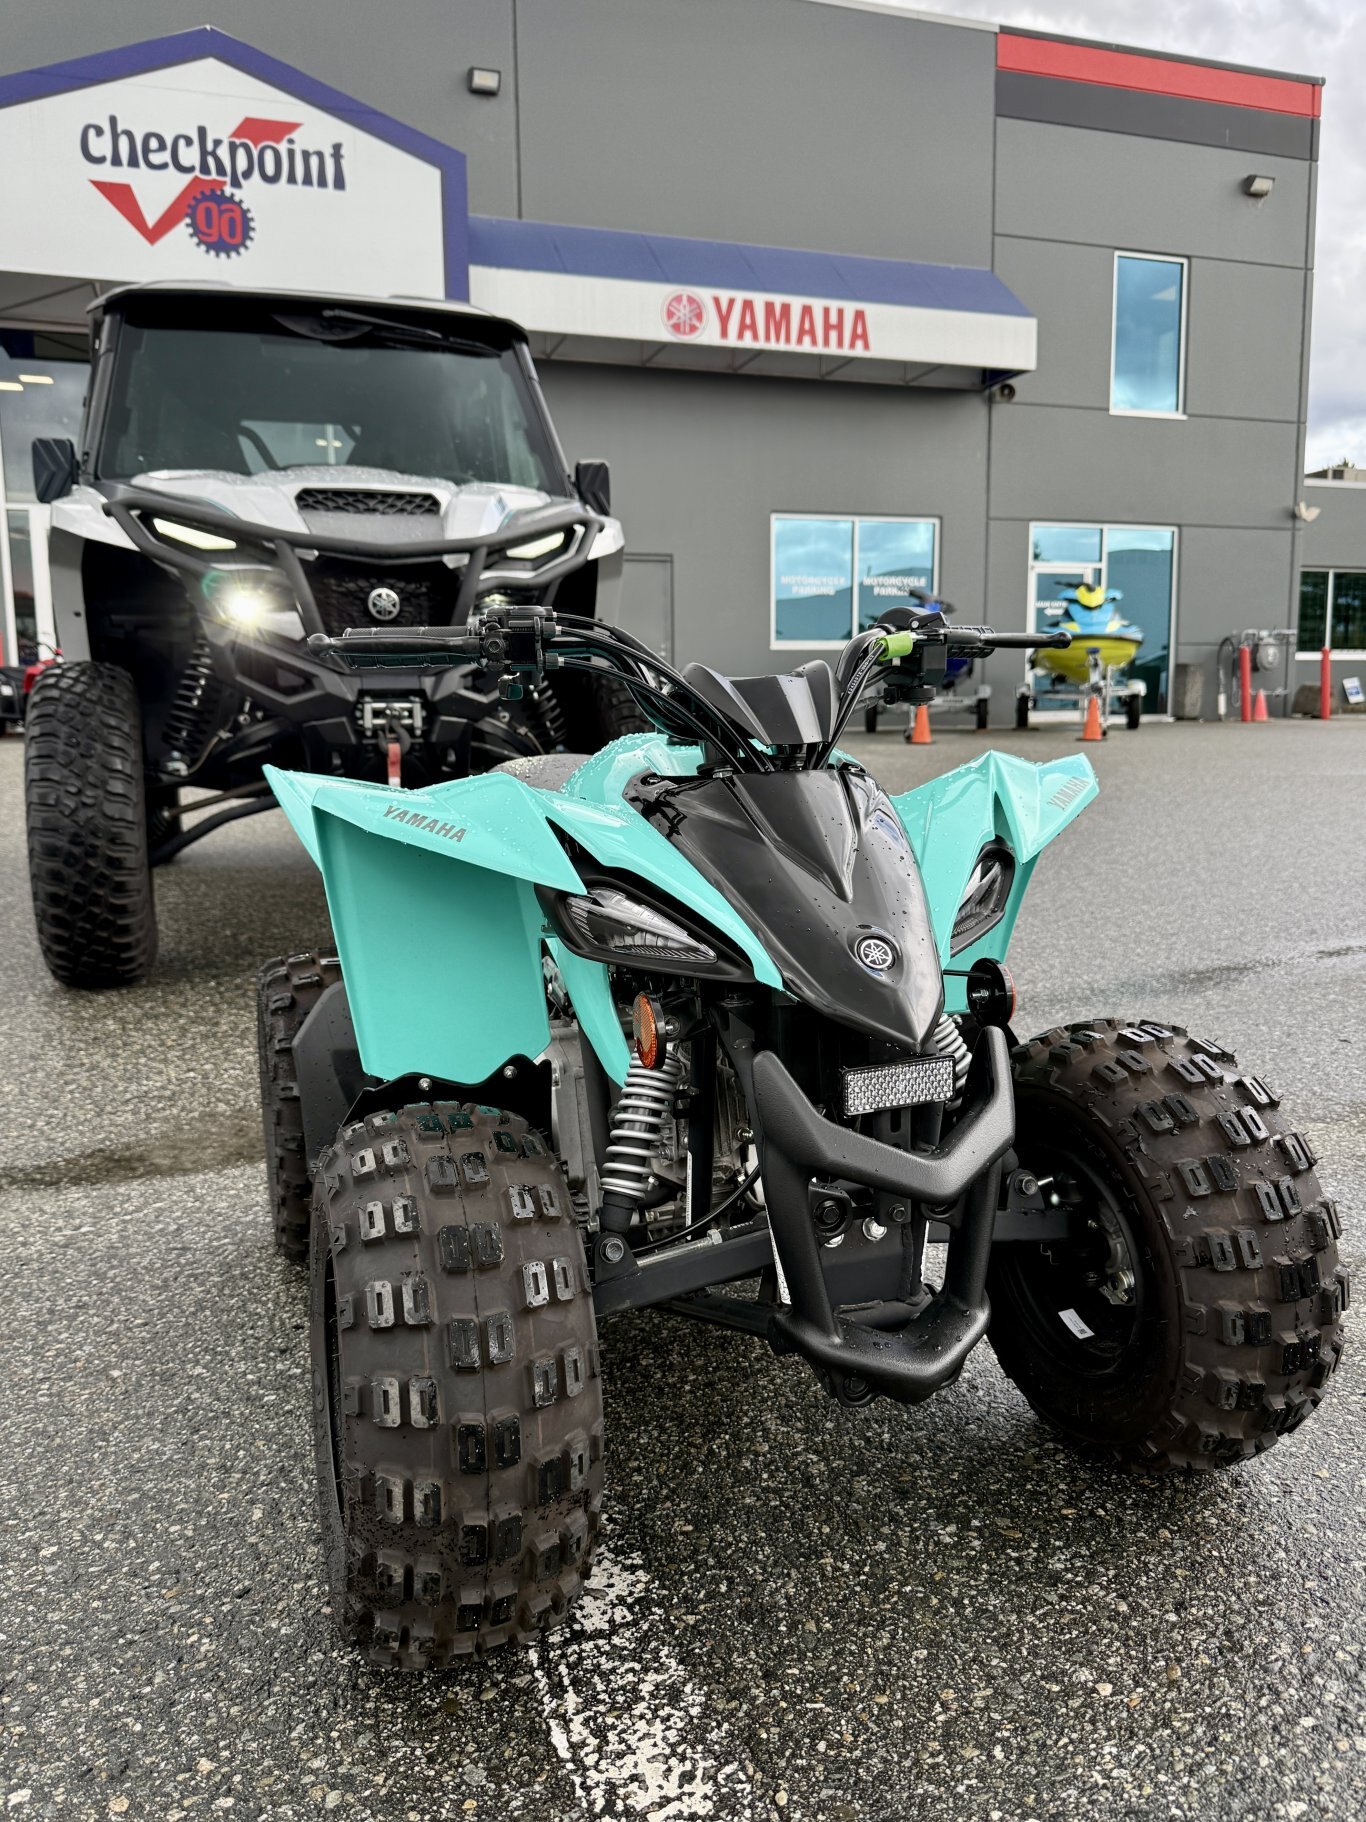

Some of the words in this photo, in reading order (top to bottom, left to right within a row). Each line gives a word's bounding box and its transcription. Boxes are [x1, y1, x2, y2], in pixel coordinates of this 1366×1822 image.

[80, 114, 346, 191] checkpoint
[712, 295, 870, 352] YAMAHA
[863, 576, 927, 587] MOTORCYCLE
[1047, 776, 1090, 811] YAMAHA
[383, 805, 467, 843] YAMAHA
